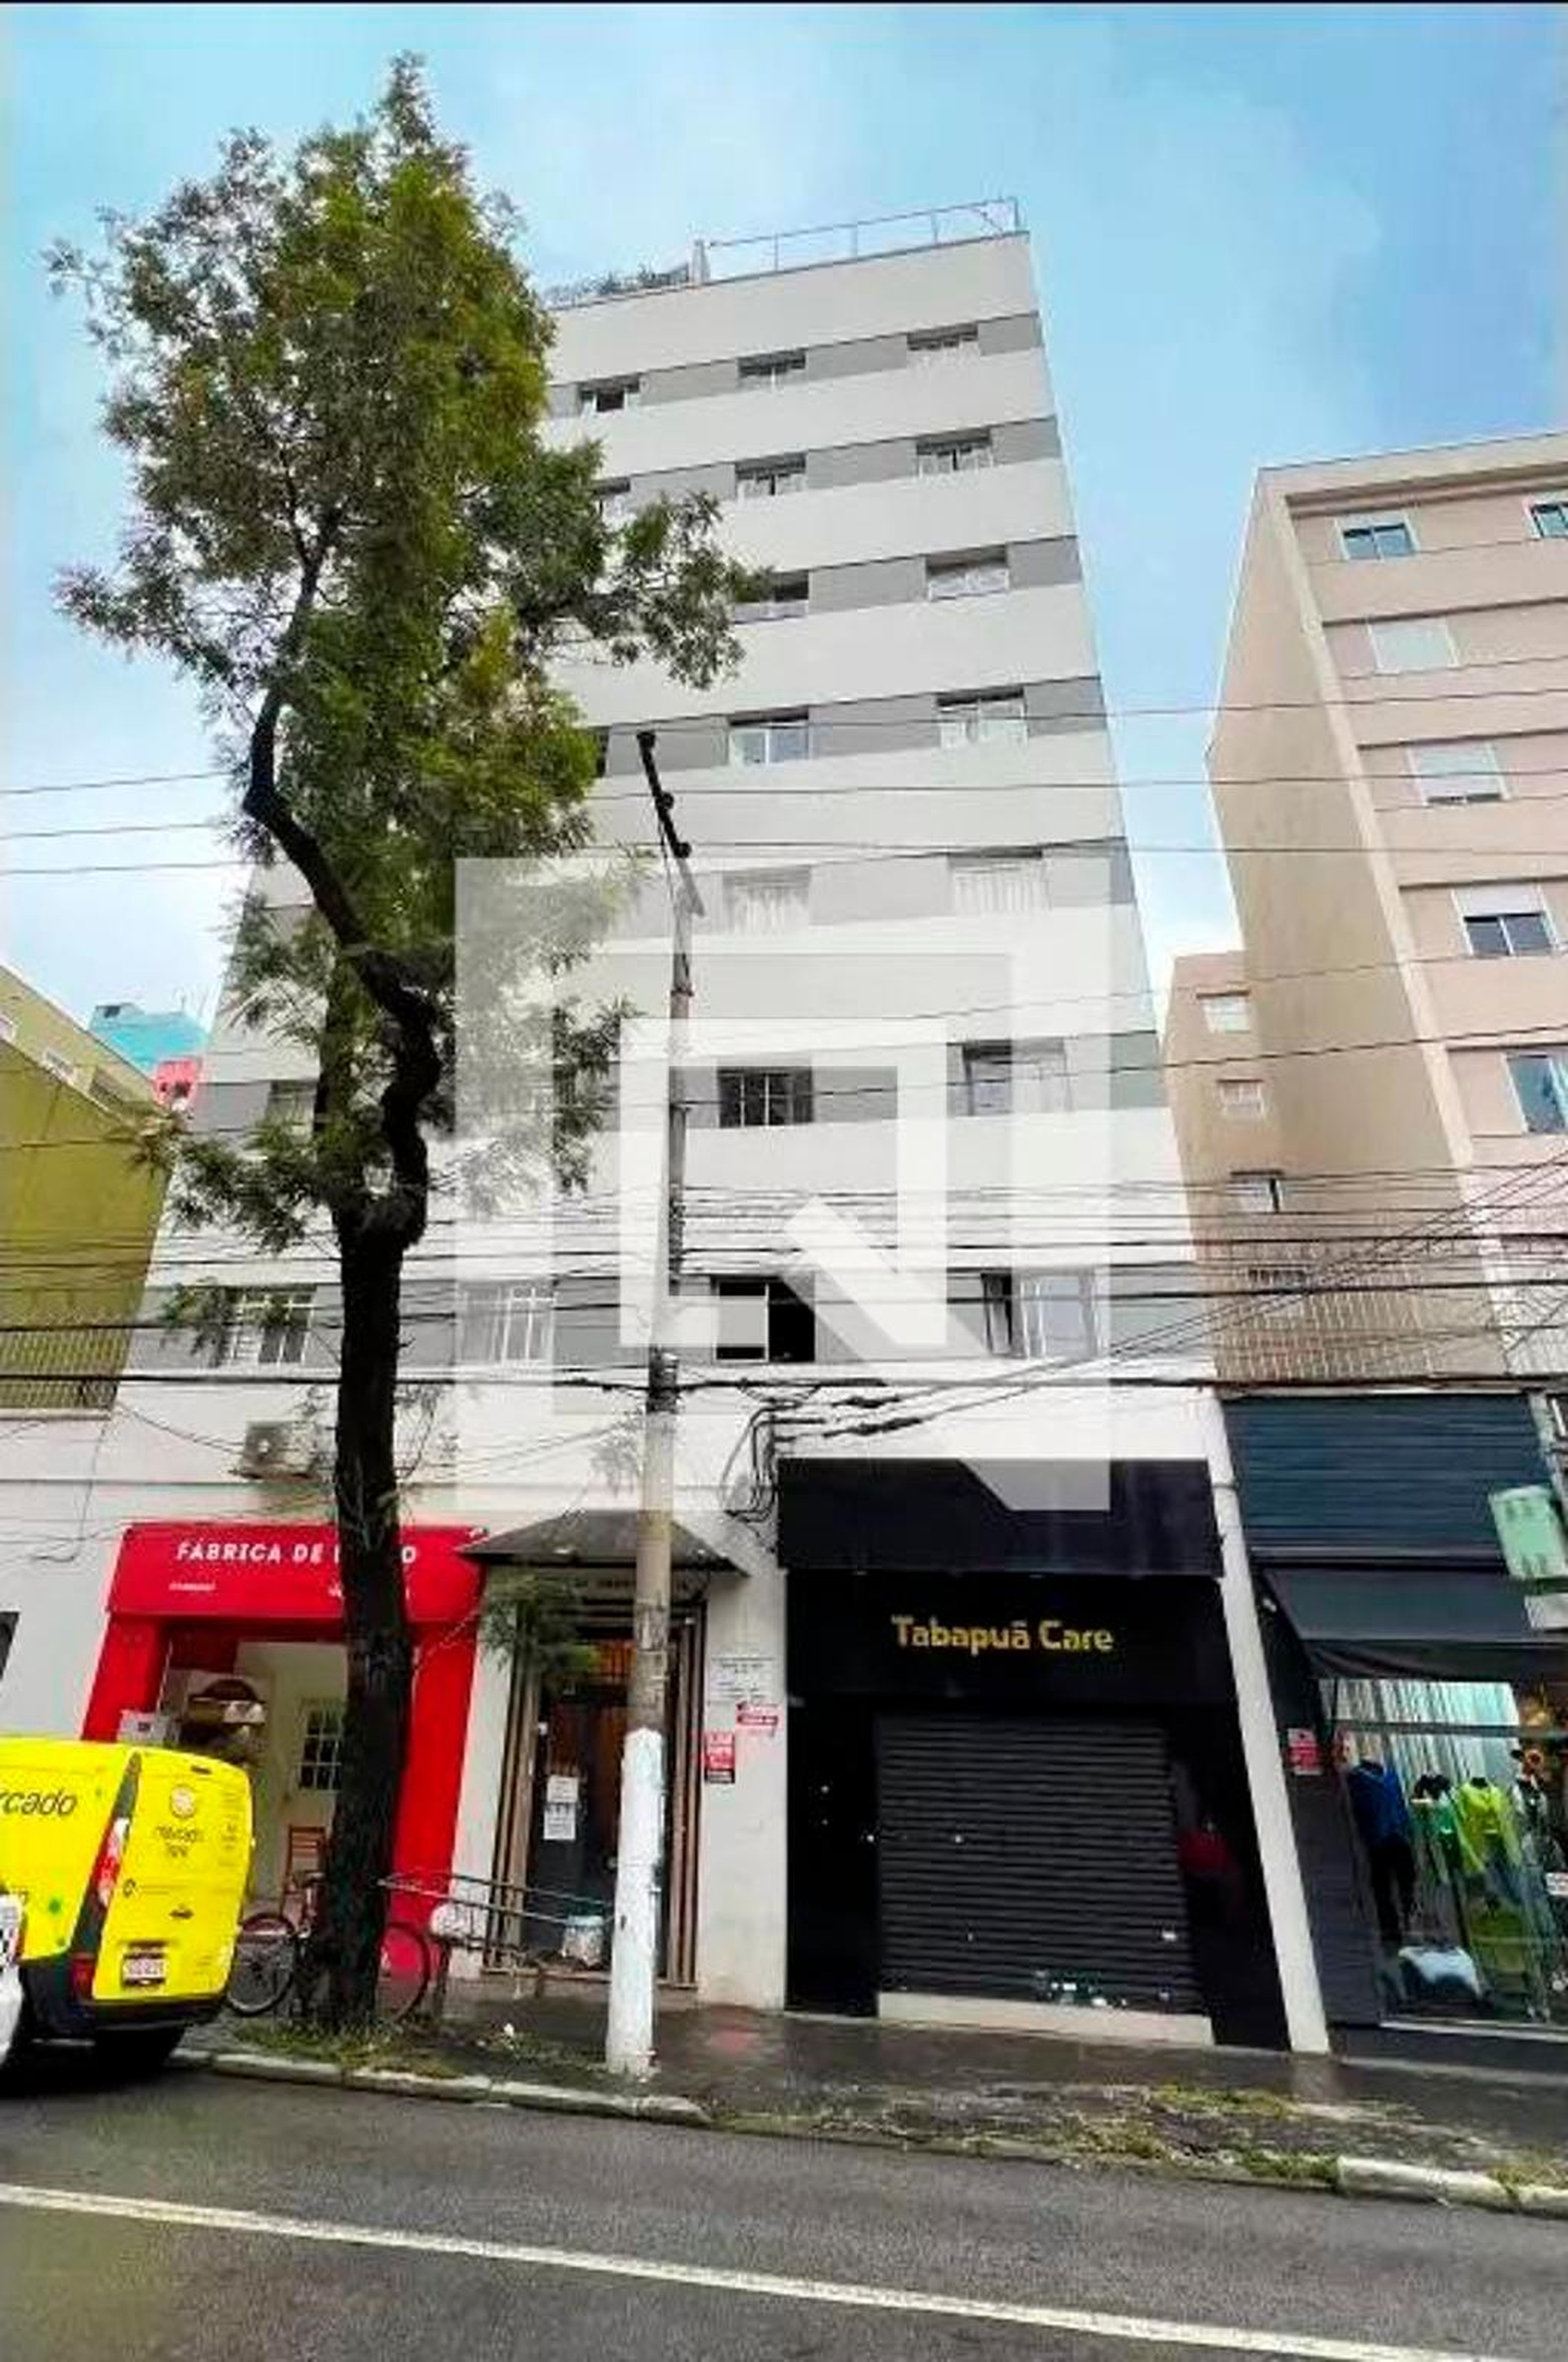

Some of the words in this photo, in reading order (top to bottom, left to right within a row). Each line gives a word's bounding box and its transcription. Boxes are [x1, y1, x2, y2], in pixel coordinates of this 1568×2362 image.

[177, 1539, 281, 1563] FÁBRICA
[293, 1543, 324, 1564] DE
[891, 1615, 1030, 1656] Tabapuã
[1039, 1620, 1114, 1652] Care
